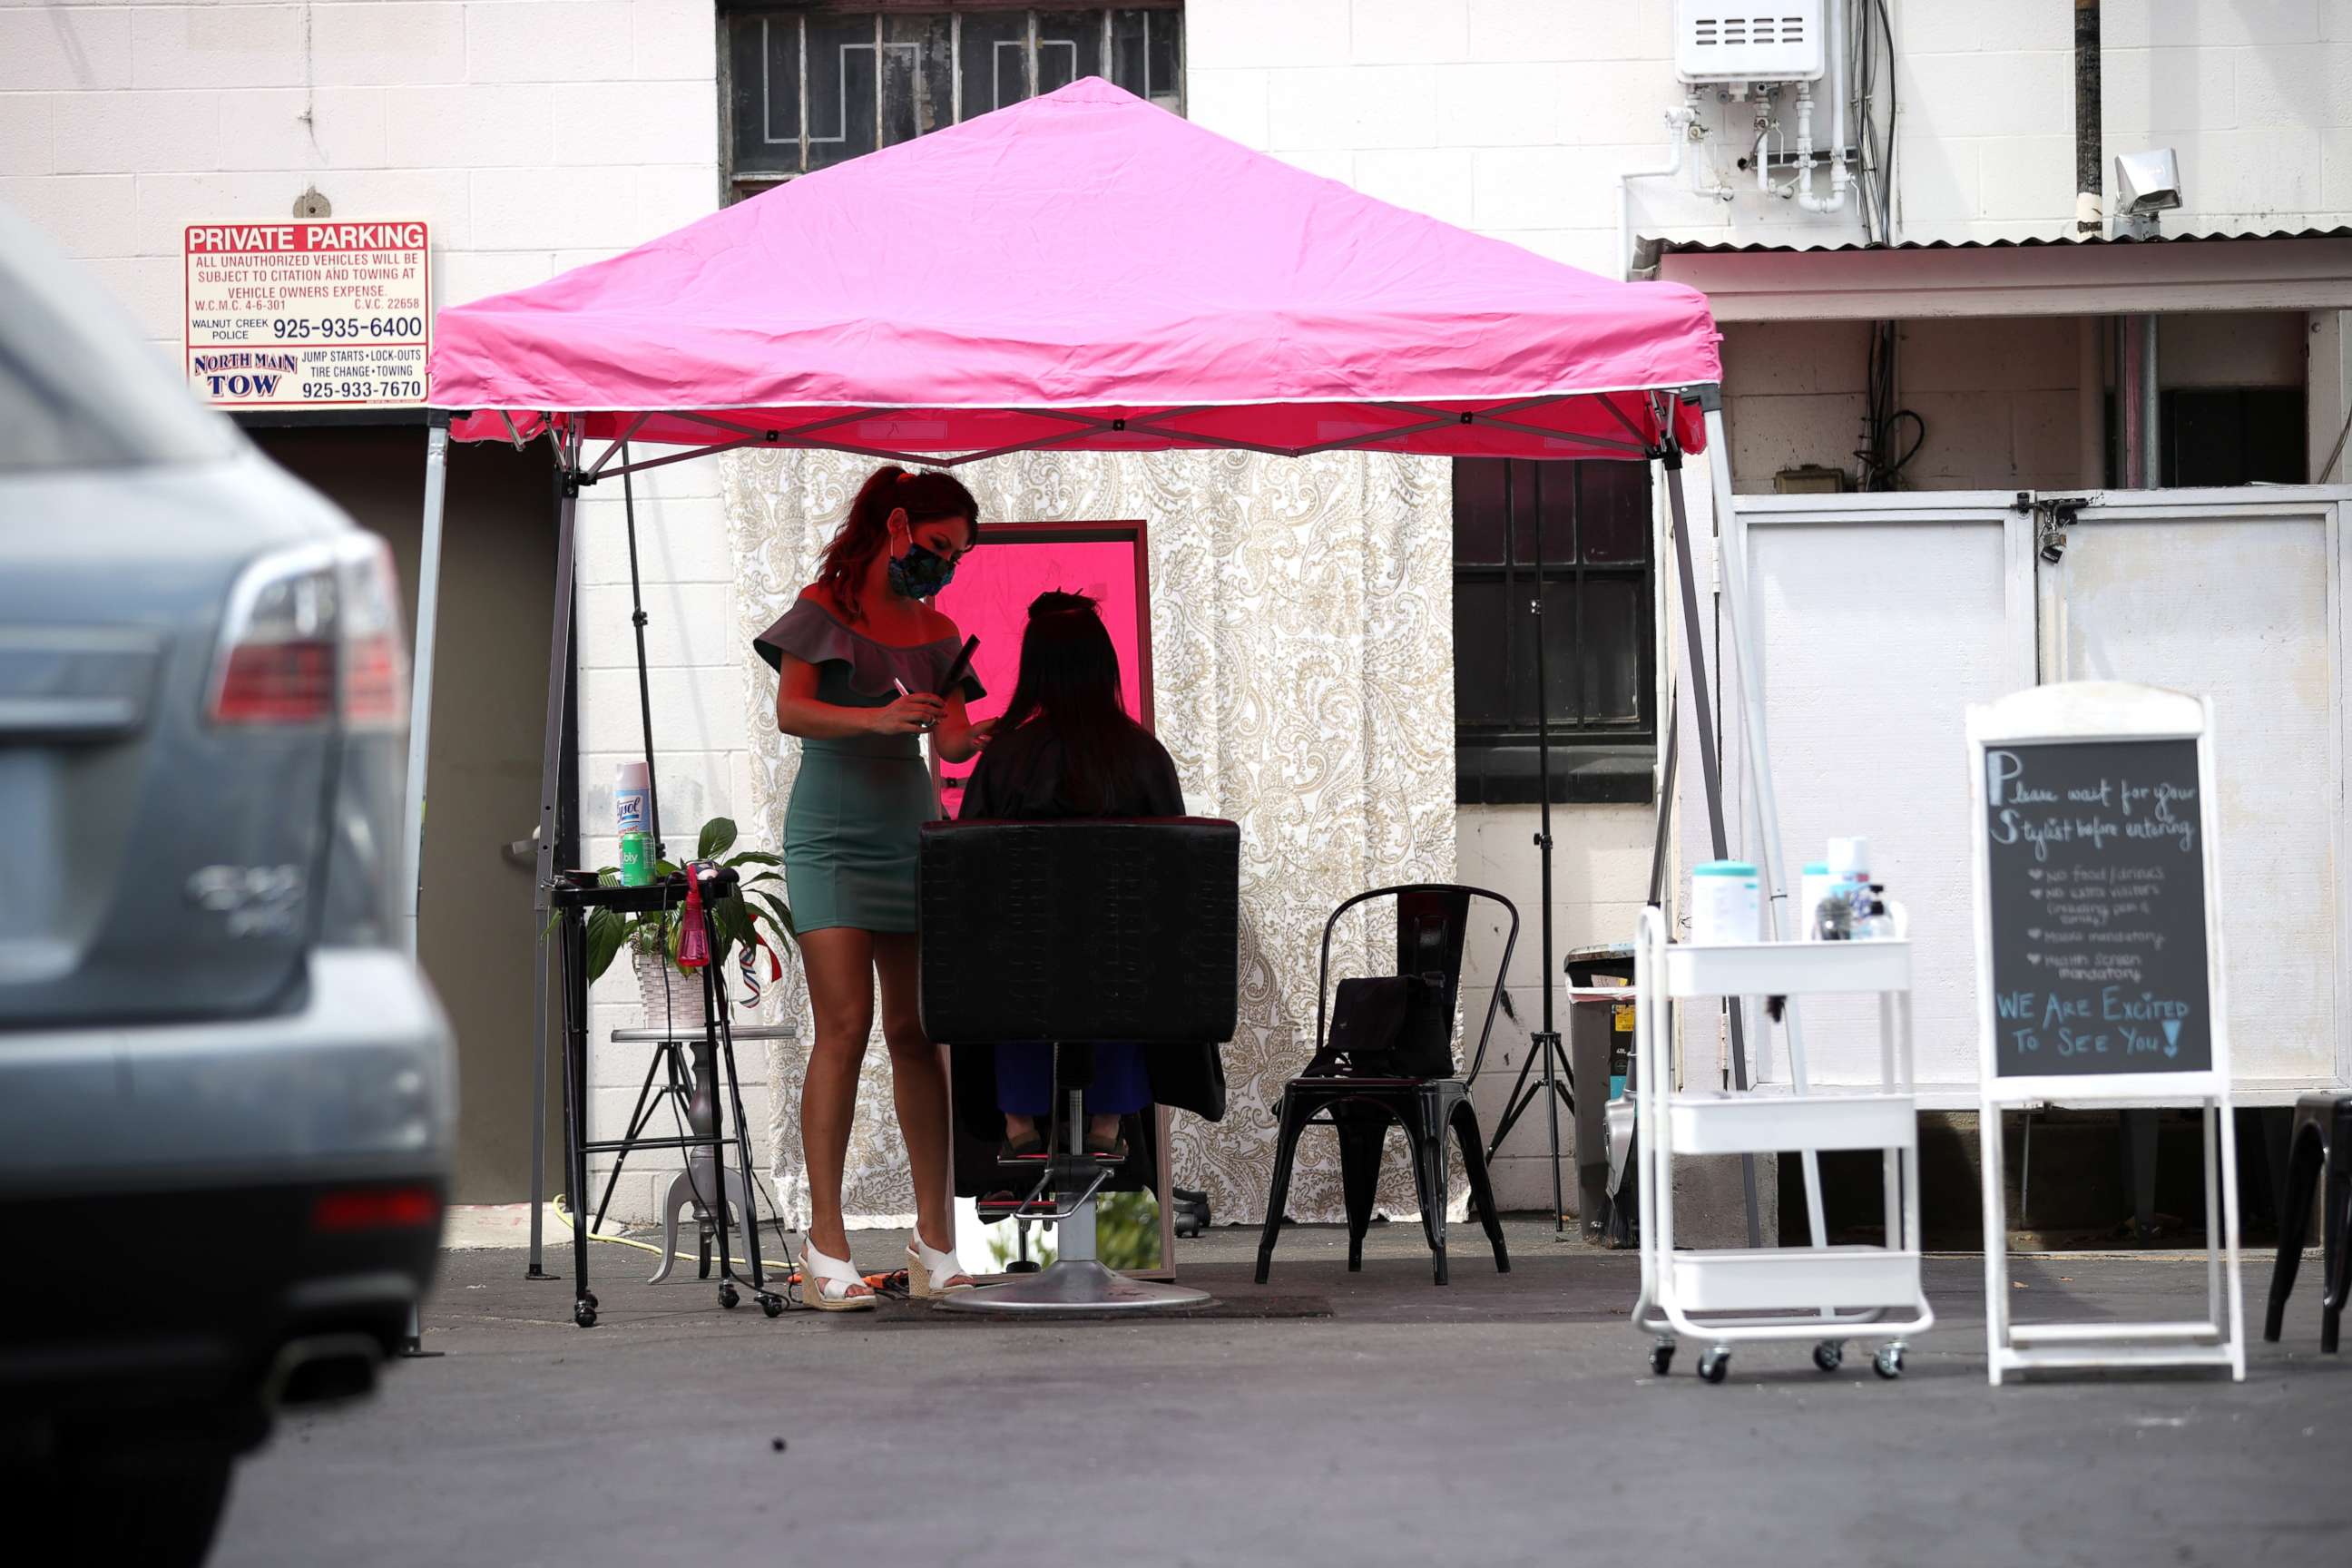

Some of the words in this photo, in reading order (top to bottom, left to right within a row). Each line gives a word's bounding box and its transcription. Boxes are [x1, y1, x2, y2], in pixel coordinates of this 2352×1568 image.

[189, 226, 295, 251] PRIVATE
[307, 224, 424, 250] PARKING
[196, 256, 217, 268] ALL
[220, 255, 309, 268] UNAUTHORIZED
[313, 253, 368, 266] VEHICLES
[372, 253, 399, 265] WILL
[404, 253, 418, 264] BE
[198, 270, 249, 283] SUBJECT
[253, 270, 267, 282] TO
[270, 270, 321, 282] CITATION
[326, 270, 348, 280] AND
[352, 269, 398, 280] TOWING
[402, 268, 416, 279] AT
[228, 287, 276, 299] VEHICLE
[279, 286, 328, 299] OWNERS
[333, 285, 387, 298] EXPENSE.
[195, 300, 242, 311] W.C.M.C.
[245, 299, 286, 310] 4-6-301
[355, 299, 384, 309] C.V.C.
[387, 298, 419, 309] 22658
[192, 319, 231, 328] WALNUT
[236, 318, 269, 328] CREEK
[273, 318, 422, 338] 925-935-6400
[212, 330, 249, 339] POLICE
[301, 351, 328, 363] JUMP
[330, 350, 364, 362] STARTS
[370, 349, 421, 361] LOCK-OUTS
[194, 353, 252, 377] NORTH
[255, 352, 298, 374] MAIN
[310, 367, 330, 377] TIRE
[333, 366, 370, 377] CHANGE
[377, 365, 413, 377] TOWING
[207, 374, 282, 397] TOW
[302, 380, 421, 398] 925-933-7670
[1987, 750, 2058, 807] Please
[2068, 778, 2112, 808] wait
[2121, 779, 2149, 816] for
[2153, 783, 2197, 822] your
[1990, 808, 2073, 862] Stylist
[2076, 816, 2119, 849] before
[2125, 814, 2195, 853] entering
[1996, 991, 2034, 1019] WE
